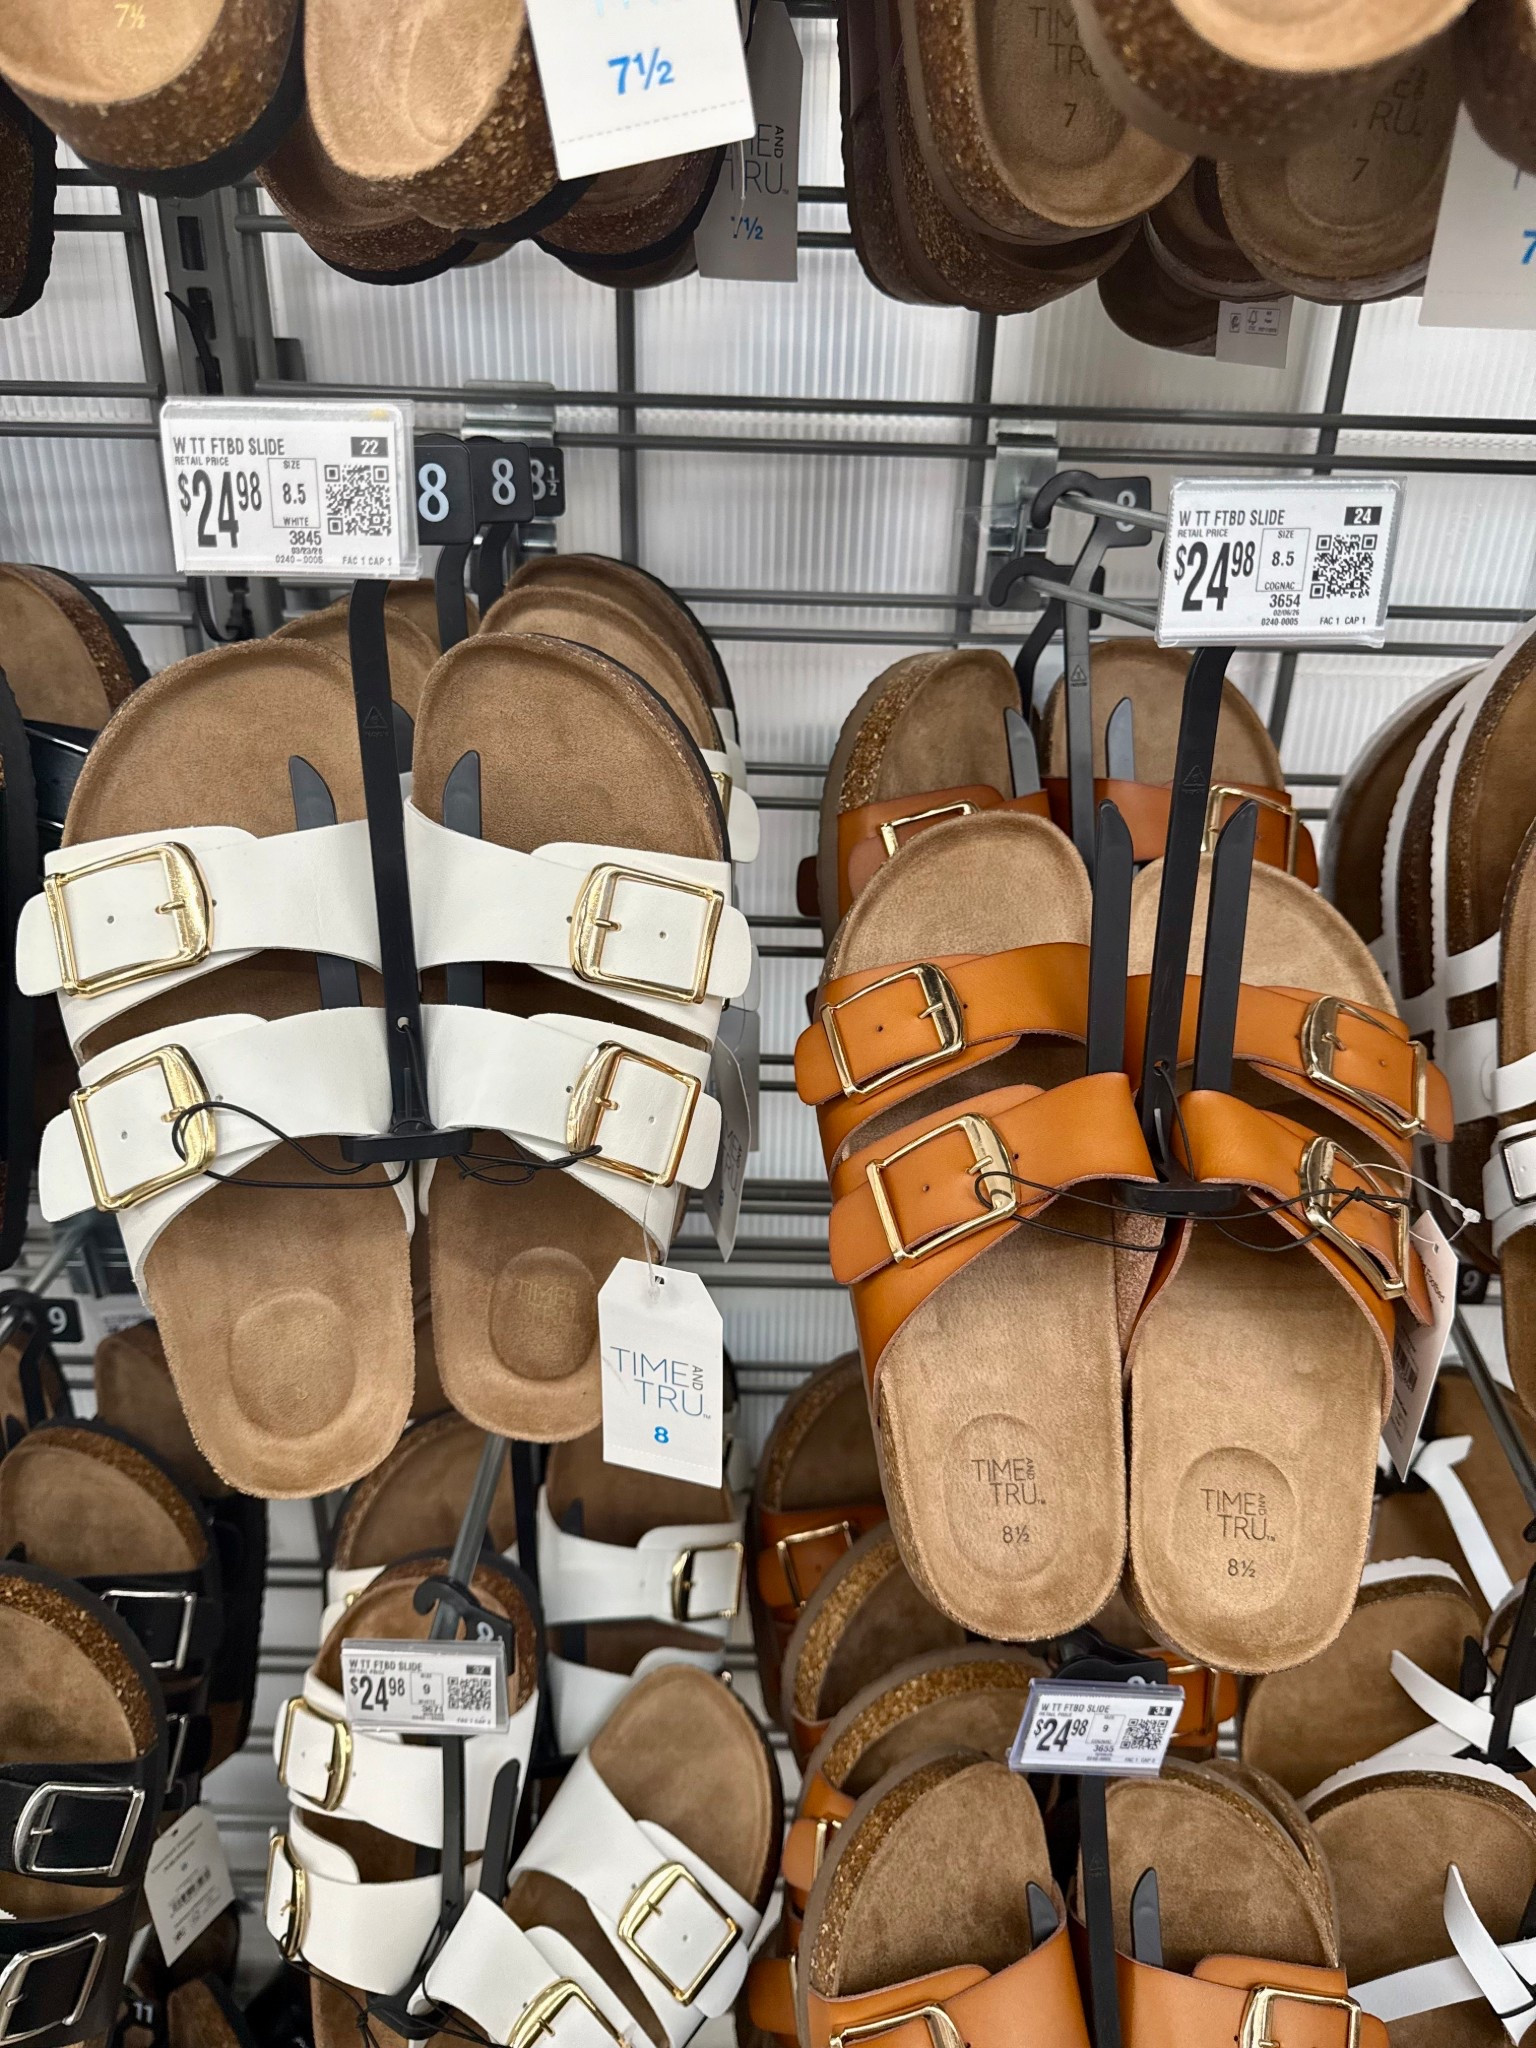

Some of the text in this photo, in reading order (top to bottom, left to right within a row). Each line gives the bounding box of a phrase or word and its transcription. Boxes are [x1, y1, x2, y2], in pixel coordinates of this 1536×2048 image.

[1029, 6, 1079, 40] TIM
[1064, 102, 1078, 128] 7
[774, 125, 785, 159] AND
[1352, 157, 1370, 182] 7
[173, 437, 285, 456] W TT FTBD SLIDE
[360, 440, 379, 455] 22
[174, 456, 230, 466] RETAIL PRICE
[283, 461, 301, 470] SIZE
[491, 458, 516, 506] 8
[282, 483, 306, 504] 8.5
[418, 462, 450, 523] 8
[283, 517, 309, 526] WHITE
[1179, 509, 1285, 526] W TT FTBD SLIDE
[1353, 508, 1372, 524] 24
[289, 530, 322, 546] 3845
[1177, 528, 1228, 538] RETAIL PRICE
[1278, 530, 1295, 539] SIZE
[342, 556, 358, 565] FAC
[368, 557, 386, 566] CAP
[1272, 551, 1295, 567] 8.5
[1264, 581, 1295, 590] COGNAC
[1269, 594, 1301, 608] 3654
[1319, 616, 1334, 625] FAC
[1344, 616, 1360, 625] CAP
[48, 1306, 67, 1335] 9
[610, 1346, 703, 1391] TIME AND
[654, 1426, 669, 1444] 8
[971, 1457, 1036, 1482] TIME AND
[1200, 1488, 1267, 1516] TIME AND
[349, 1659, 422, 1672] W TT FTBD SLIDE
[423, 1683, 430, 1695] 9
[1041, 1703, 1110, 1713] W TT FTBD SLIDE
[133, 2002, 154, 2024] 11
